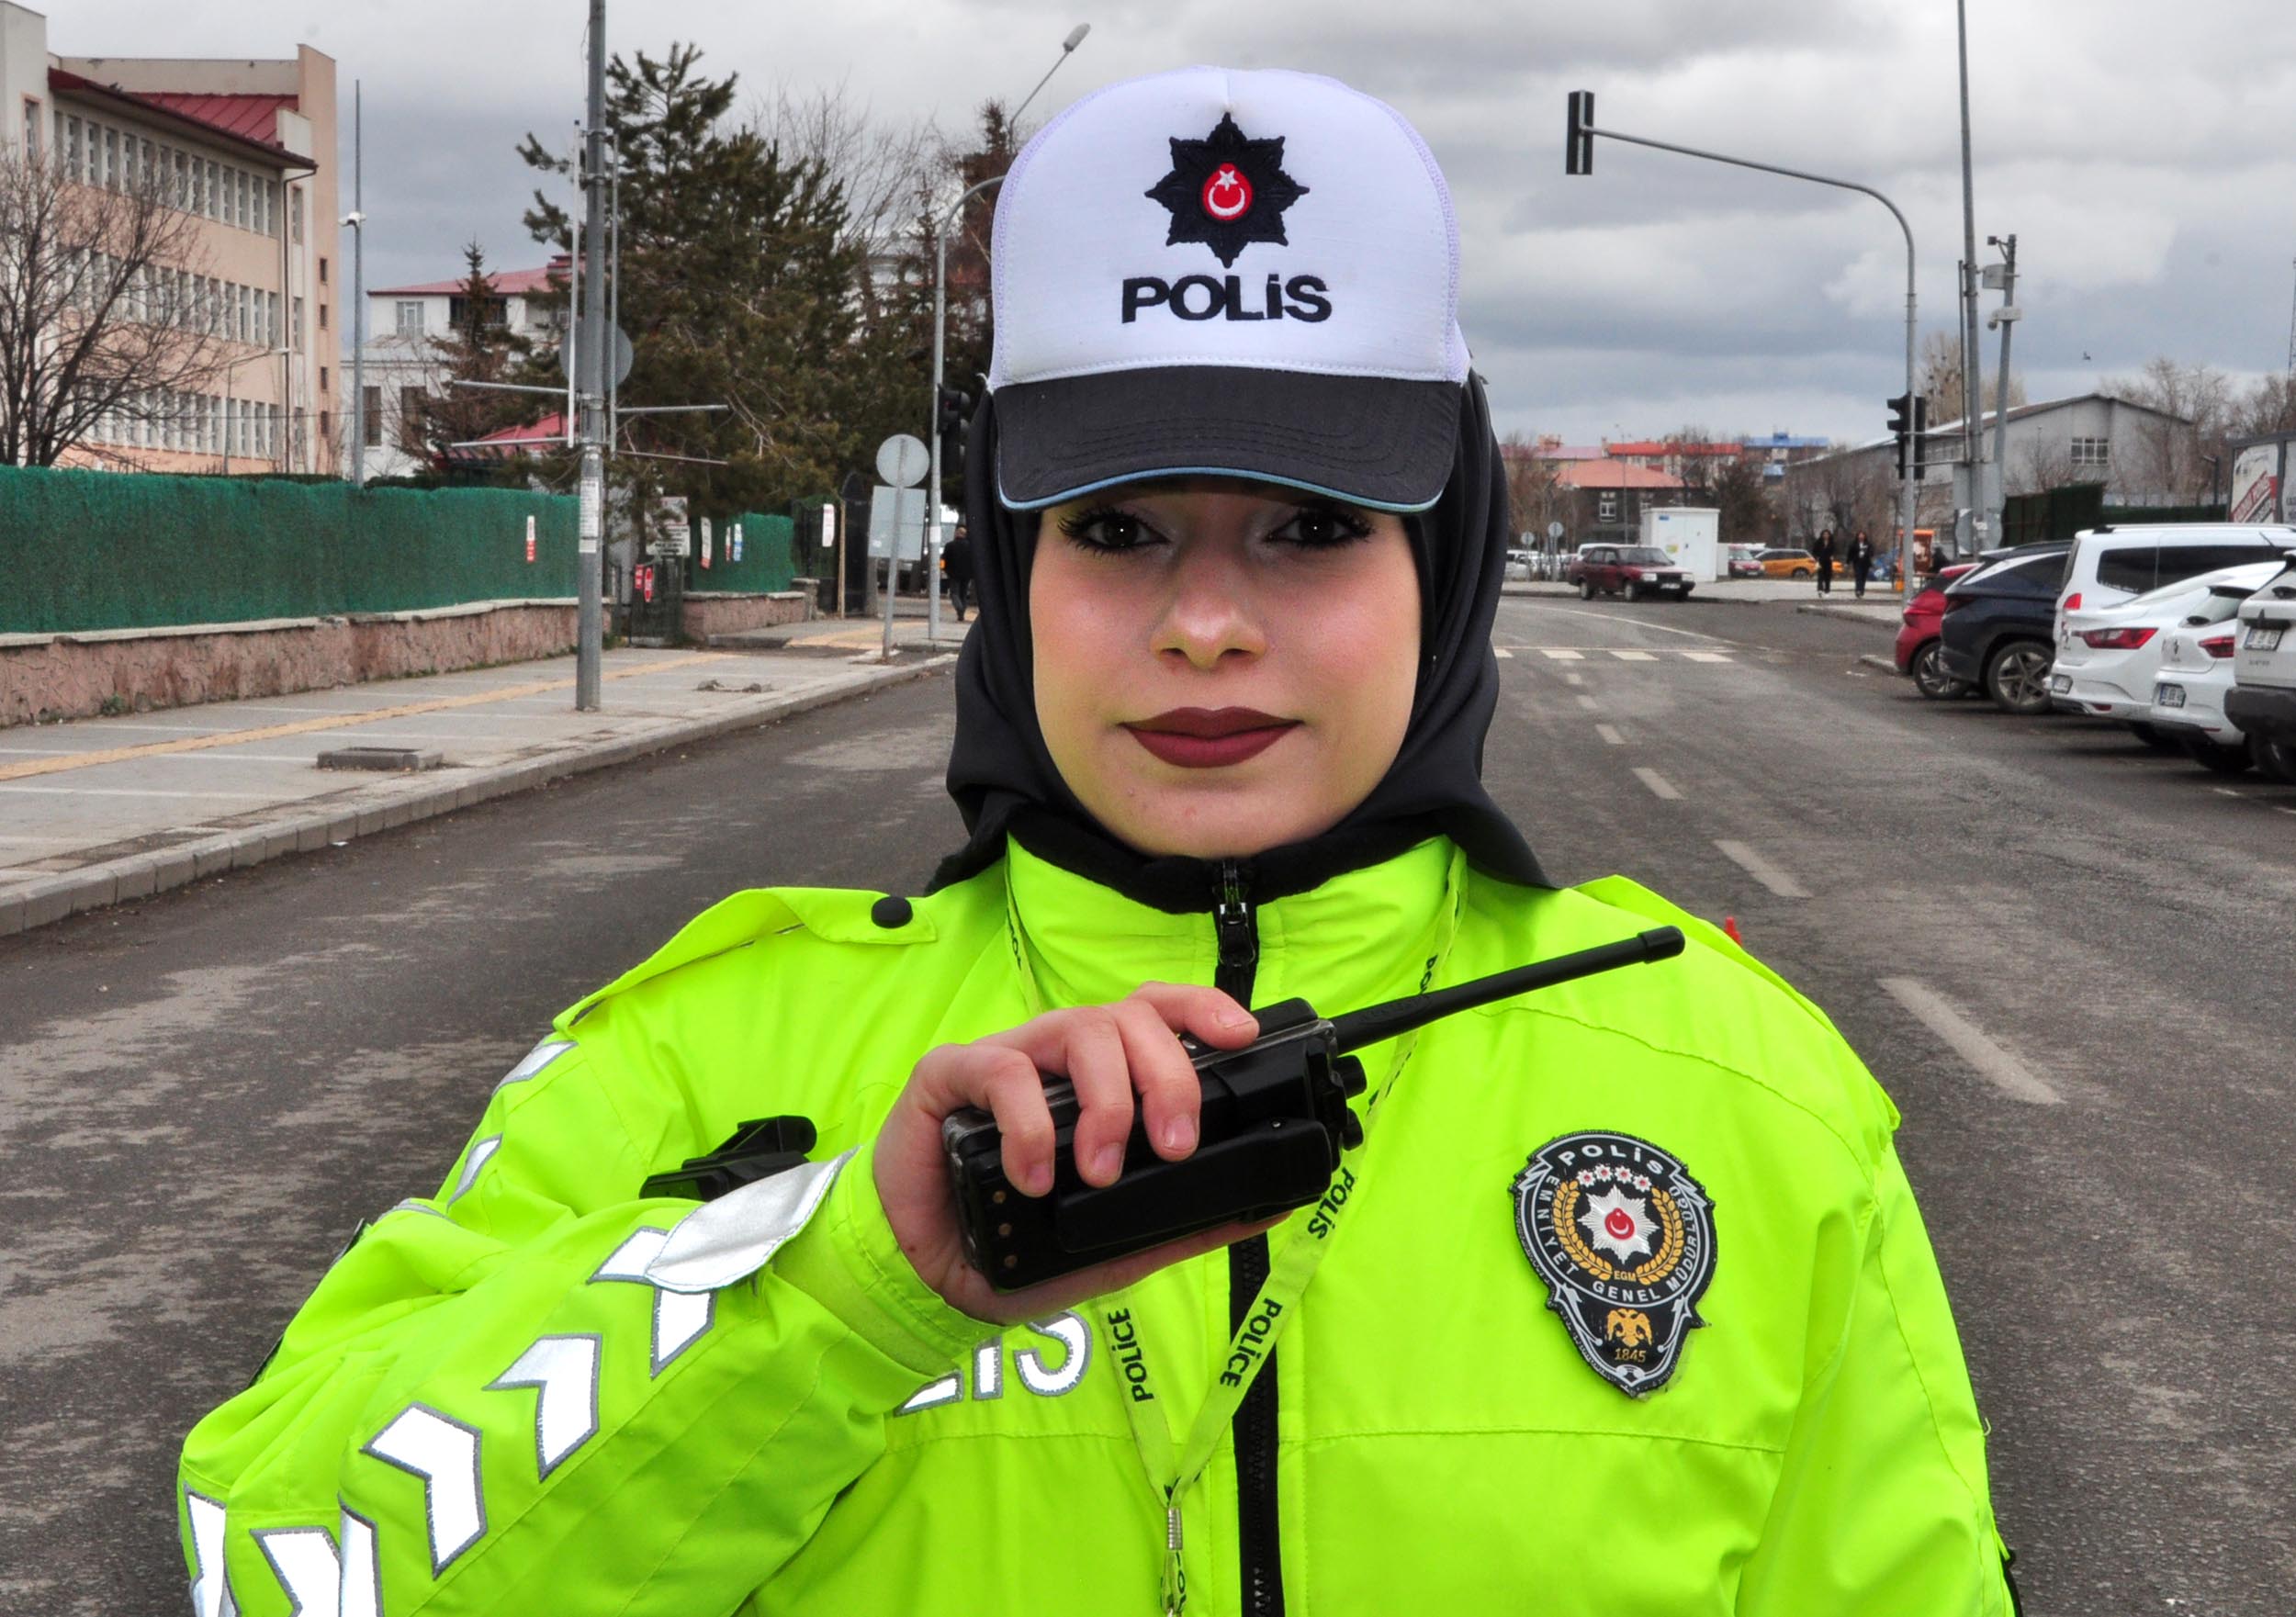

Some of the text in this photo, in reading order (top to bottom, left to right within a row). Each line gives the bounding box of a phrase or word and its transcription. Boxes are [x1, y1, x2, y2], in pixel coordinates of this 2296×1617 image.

[1614, 1270, 1638, 1283] EGM
[1592, 1280, 1661, 1302] GENEL
[1615, 1347, 1647, 1364] 1845
